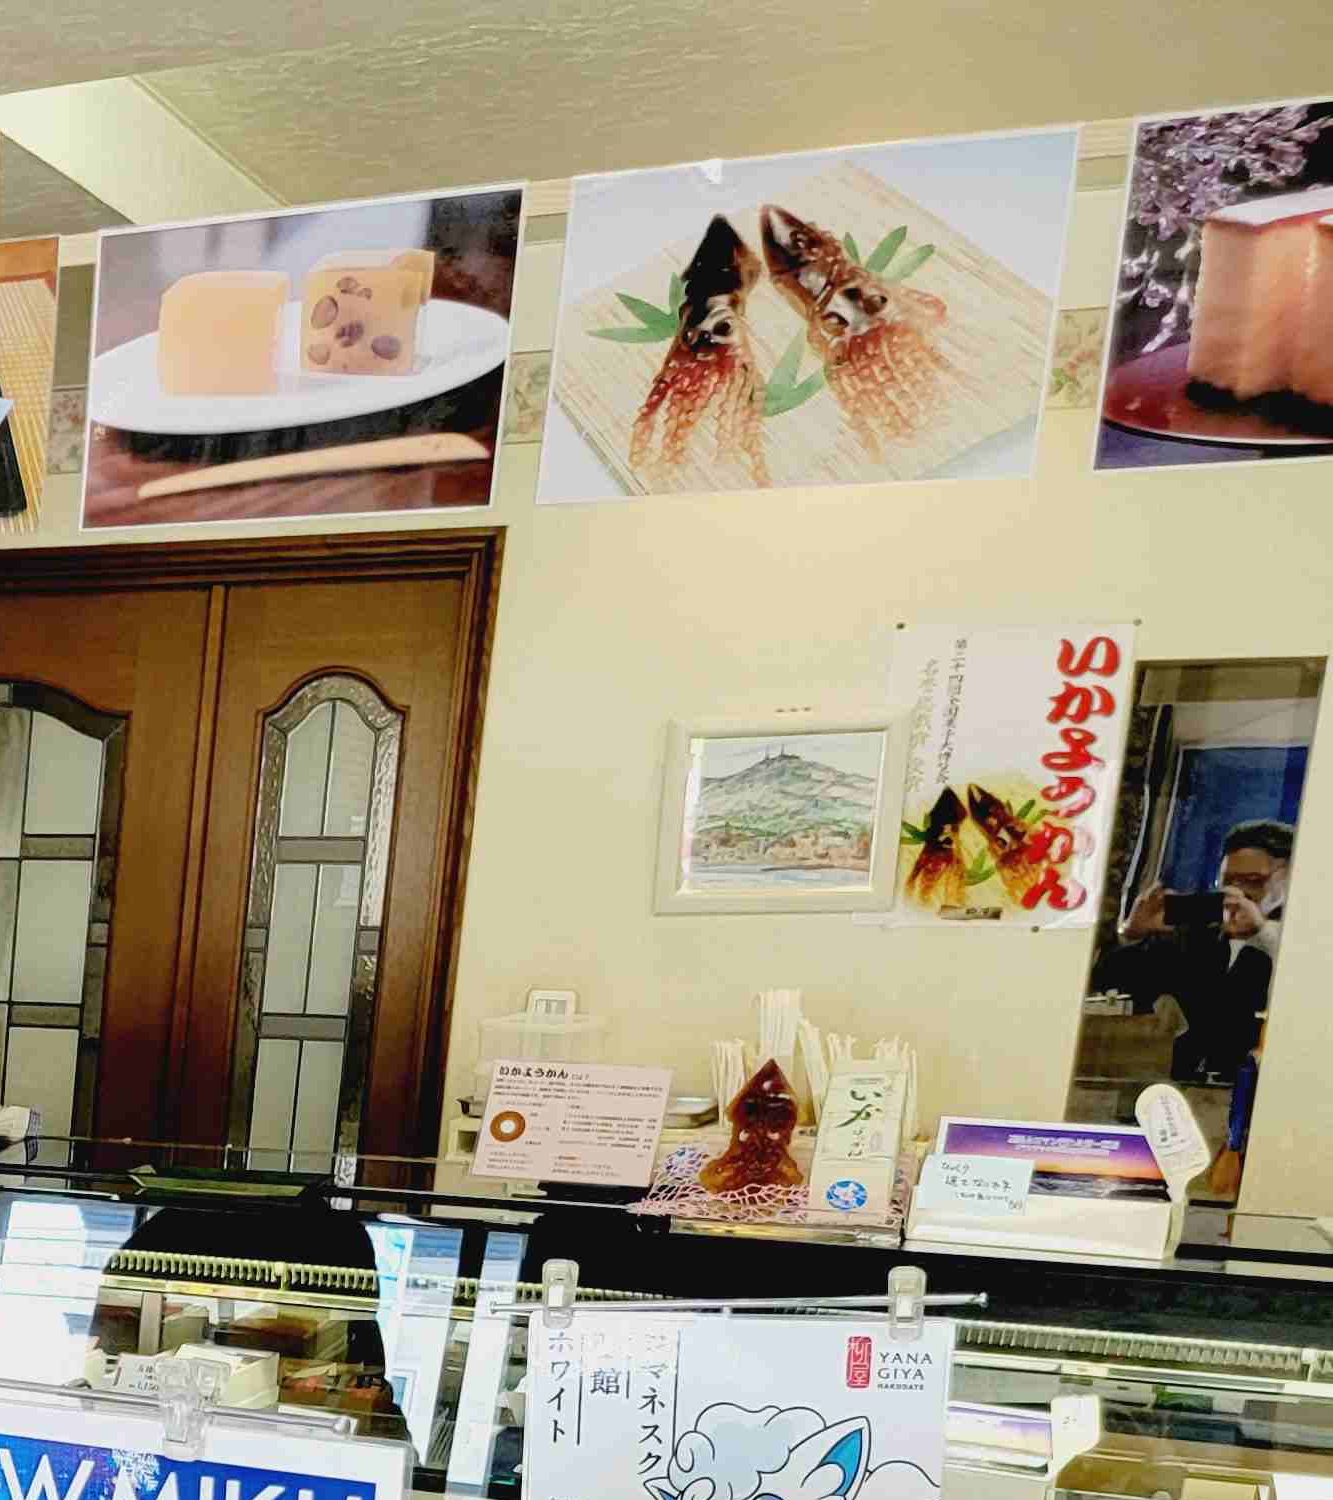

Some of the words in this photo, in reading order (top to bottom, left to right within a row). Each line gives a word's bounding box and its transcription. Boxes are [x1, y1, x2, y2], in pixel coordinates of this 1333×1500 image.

[1021, 636, 1121, 911] いかようかん
[499, 1065, 569, 1080] いかようかん
[879, 1351, 933, 1365] YANA
[877, 1367, 925, 1381] GIYA
[546, 1331, 574, 1444] ホワイト
